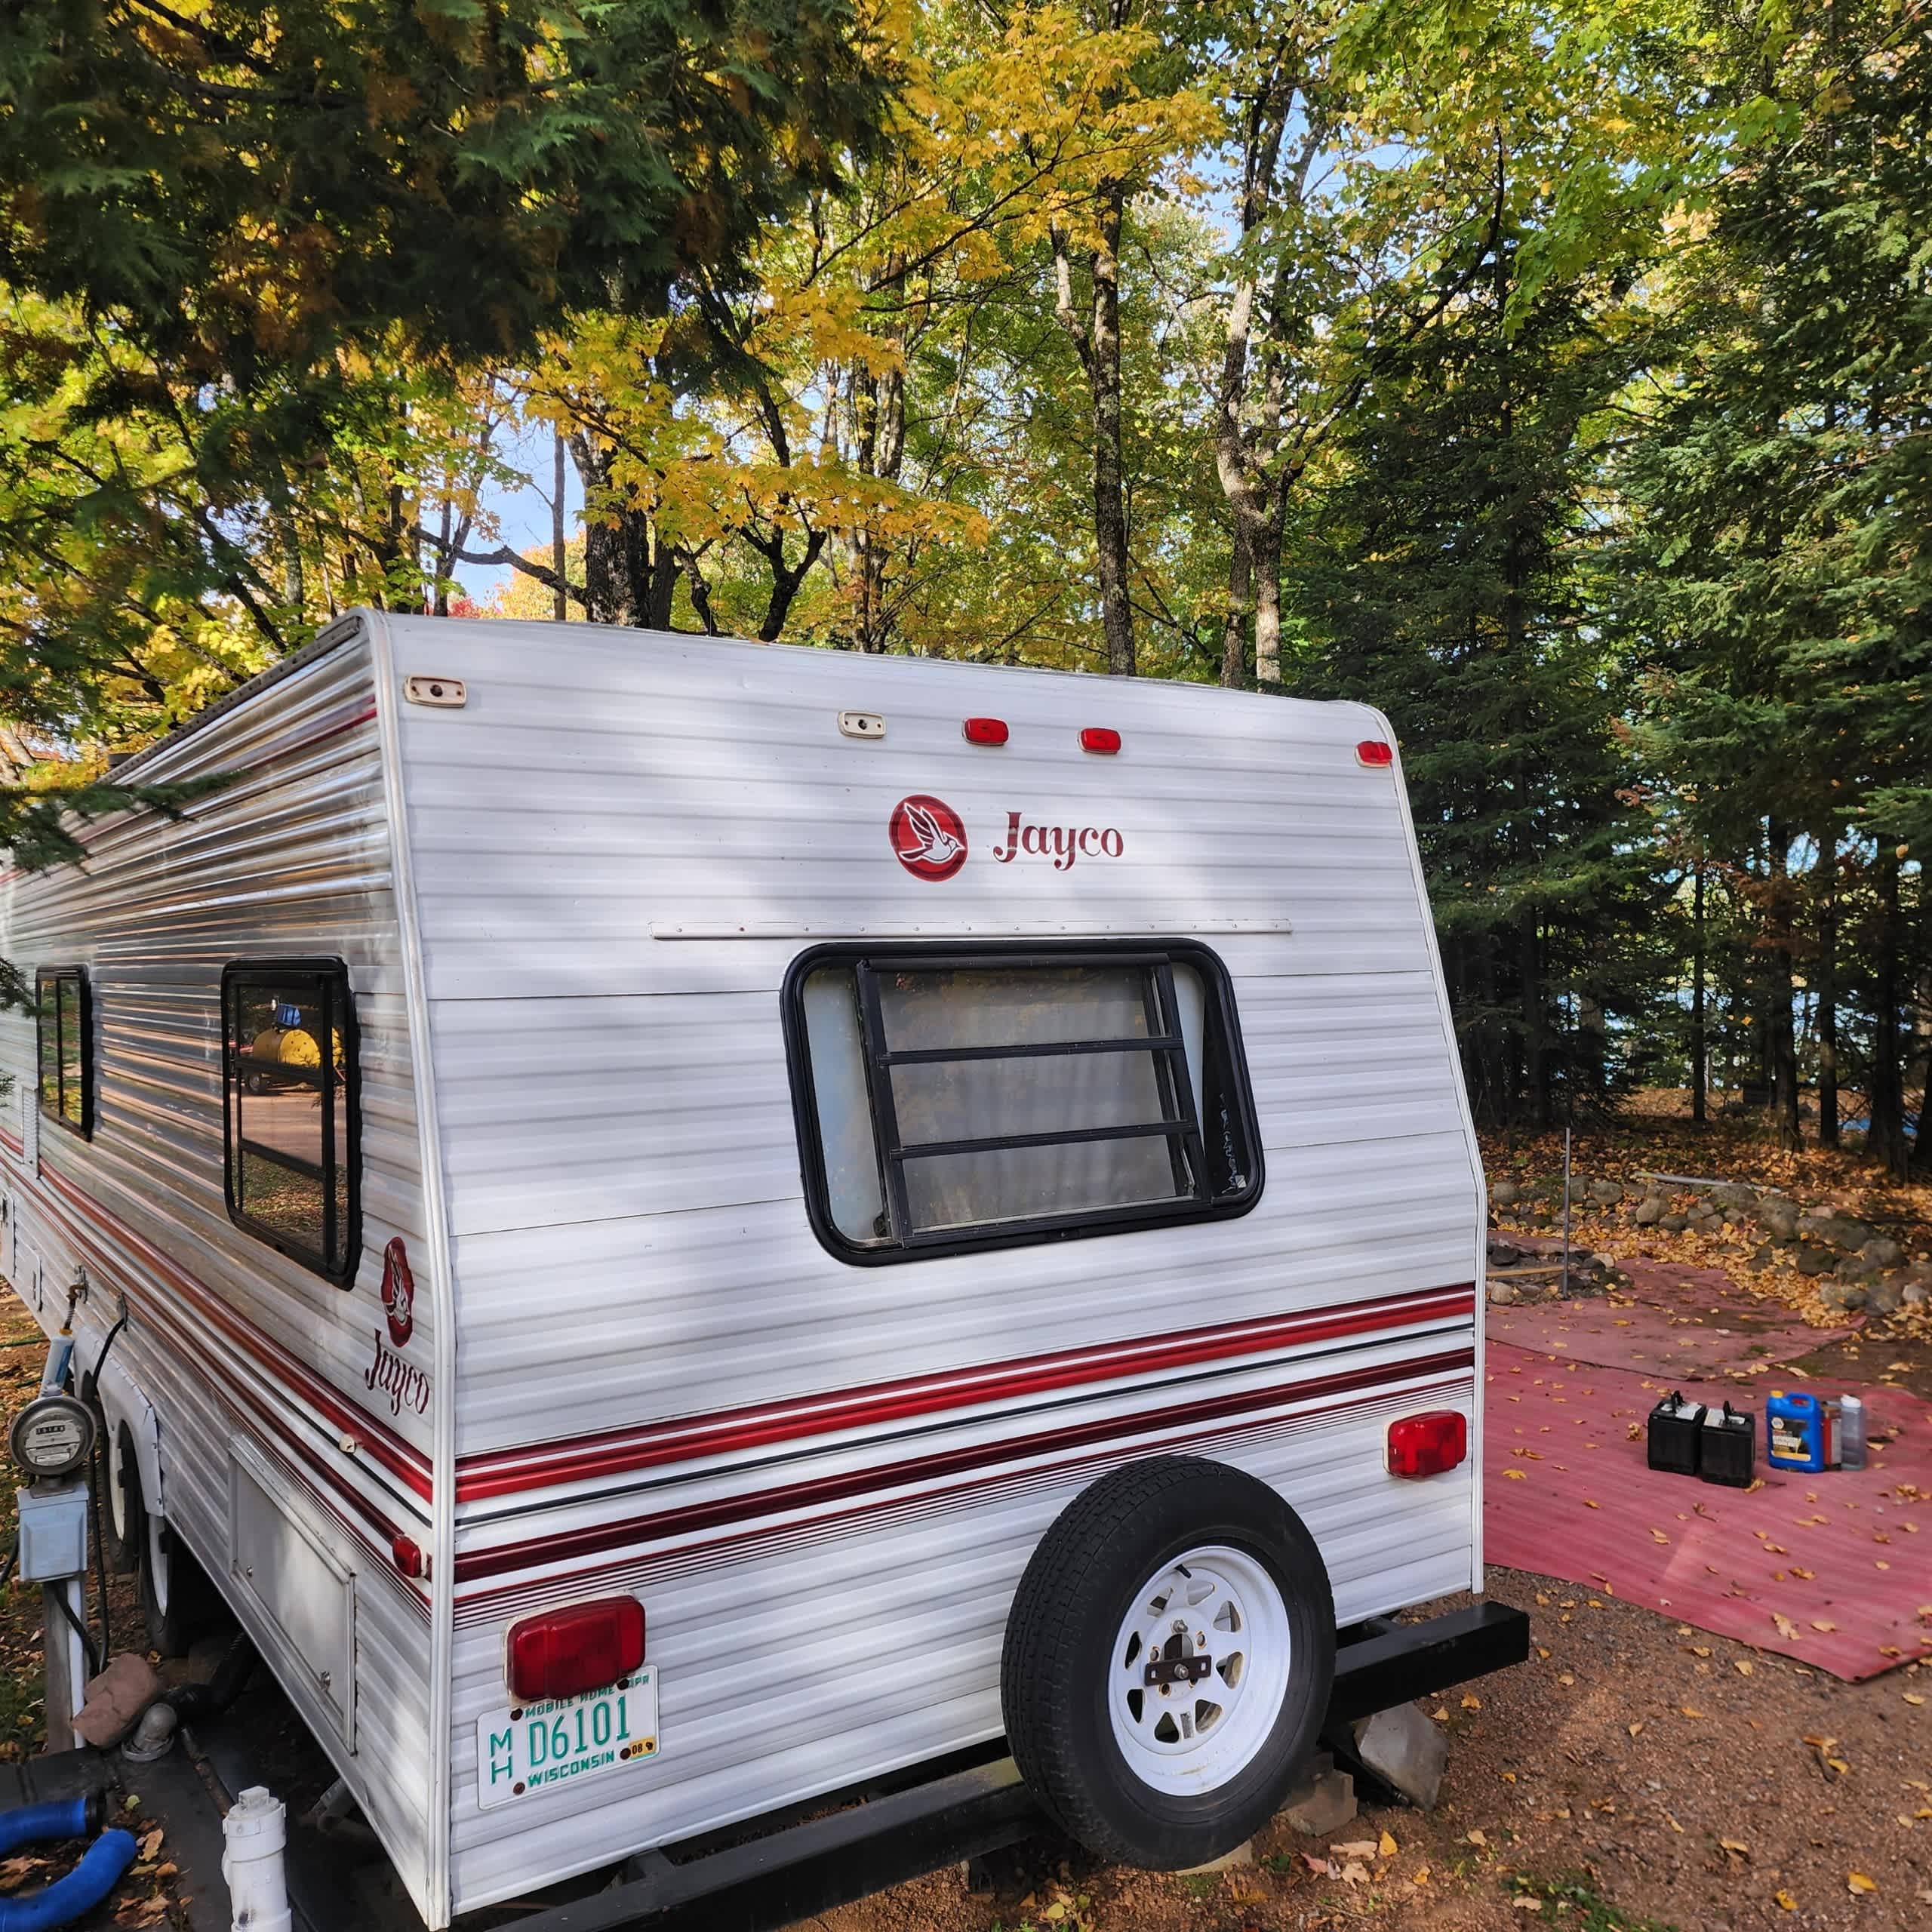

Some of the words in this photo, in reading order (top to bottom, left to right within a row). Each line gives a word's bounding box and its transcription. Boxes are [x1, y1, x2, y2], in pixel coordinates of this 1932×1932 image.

[992, 811, 1124, 871] Jayco
[365, 1328, 429, 1416] Jayco
[524, 1698, 574, 1718] MOBILE
[528, 1695, 630, 1767] D6101
[528, 1750, 615, 1788] WISCONSIN
[631, 1744, 643, 1755] 08
